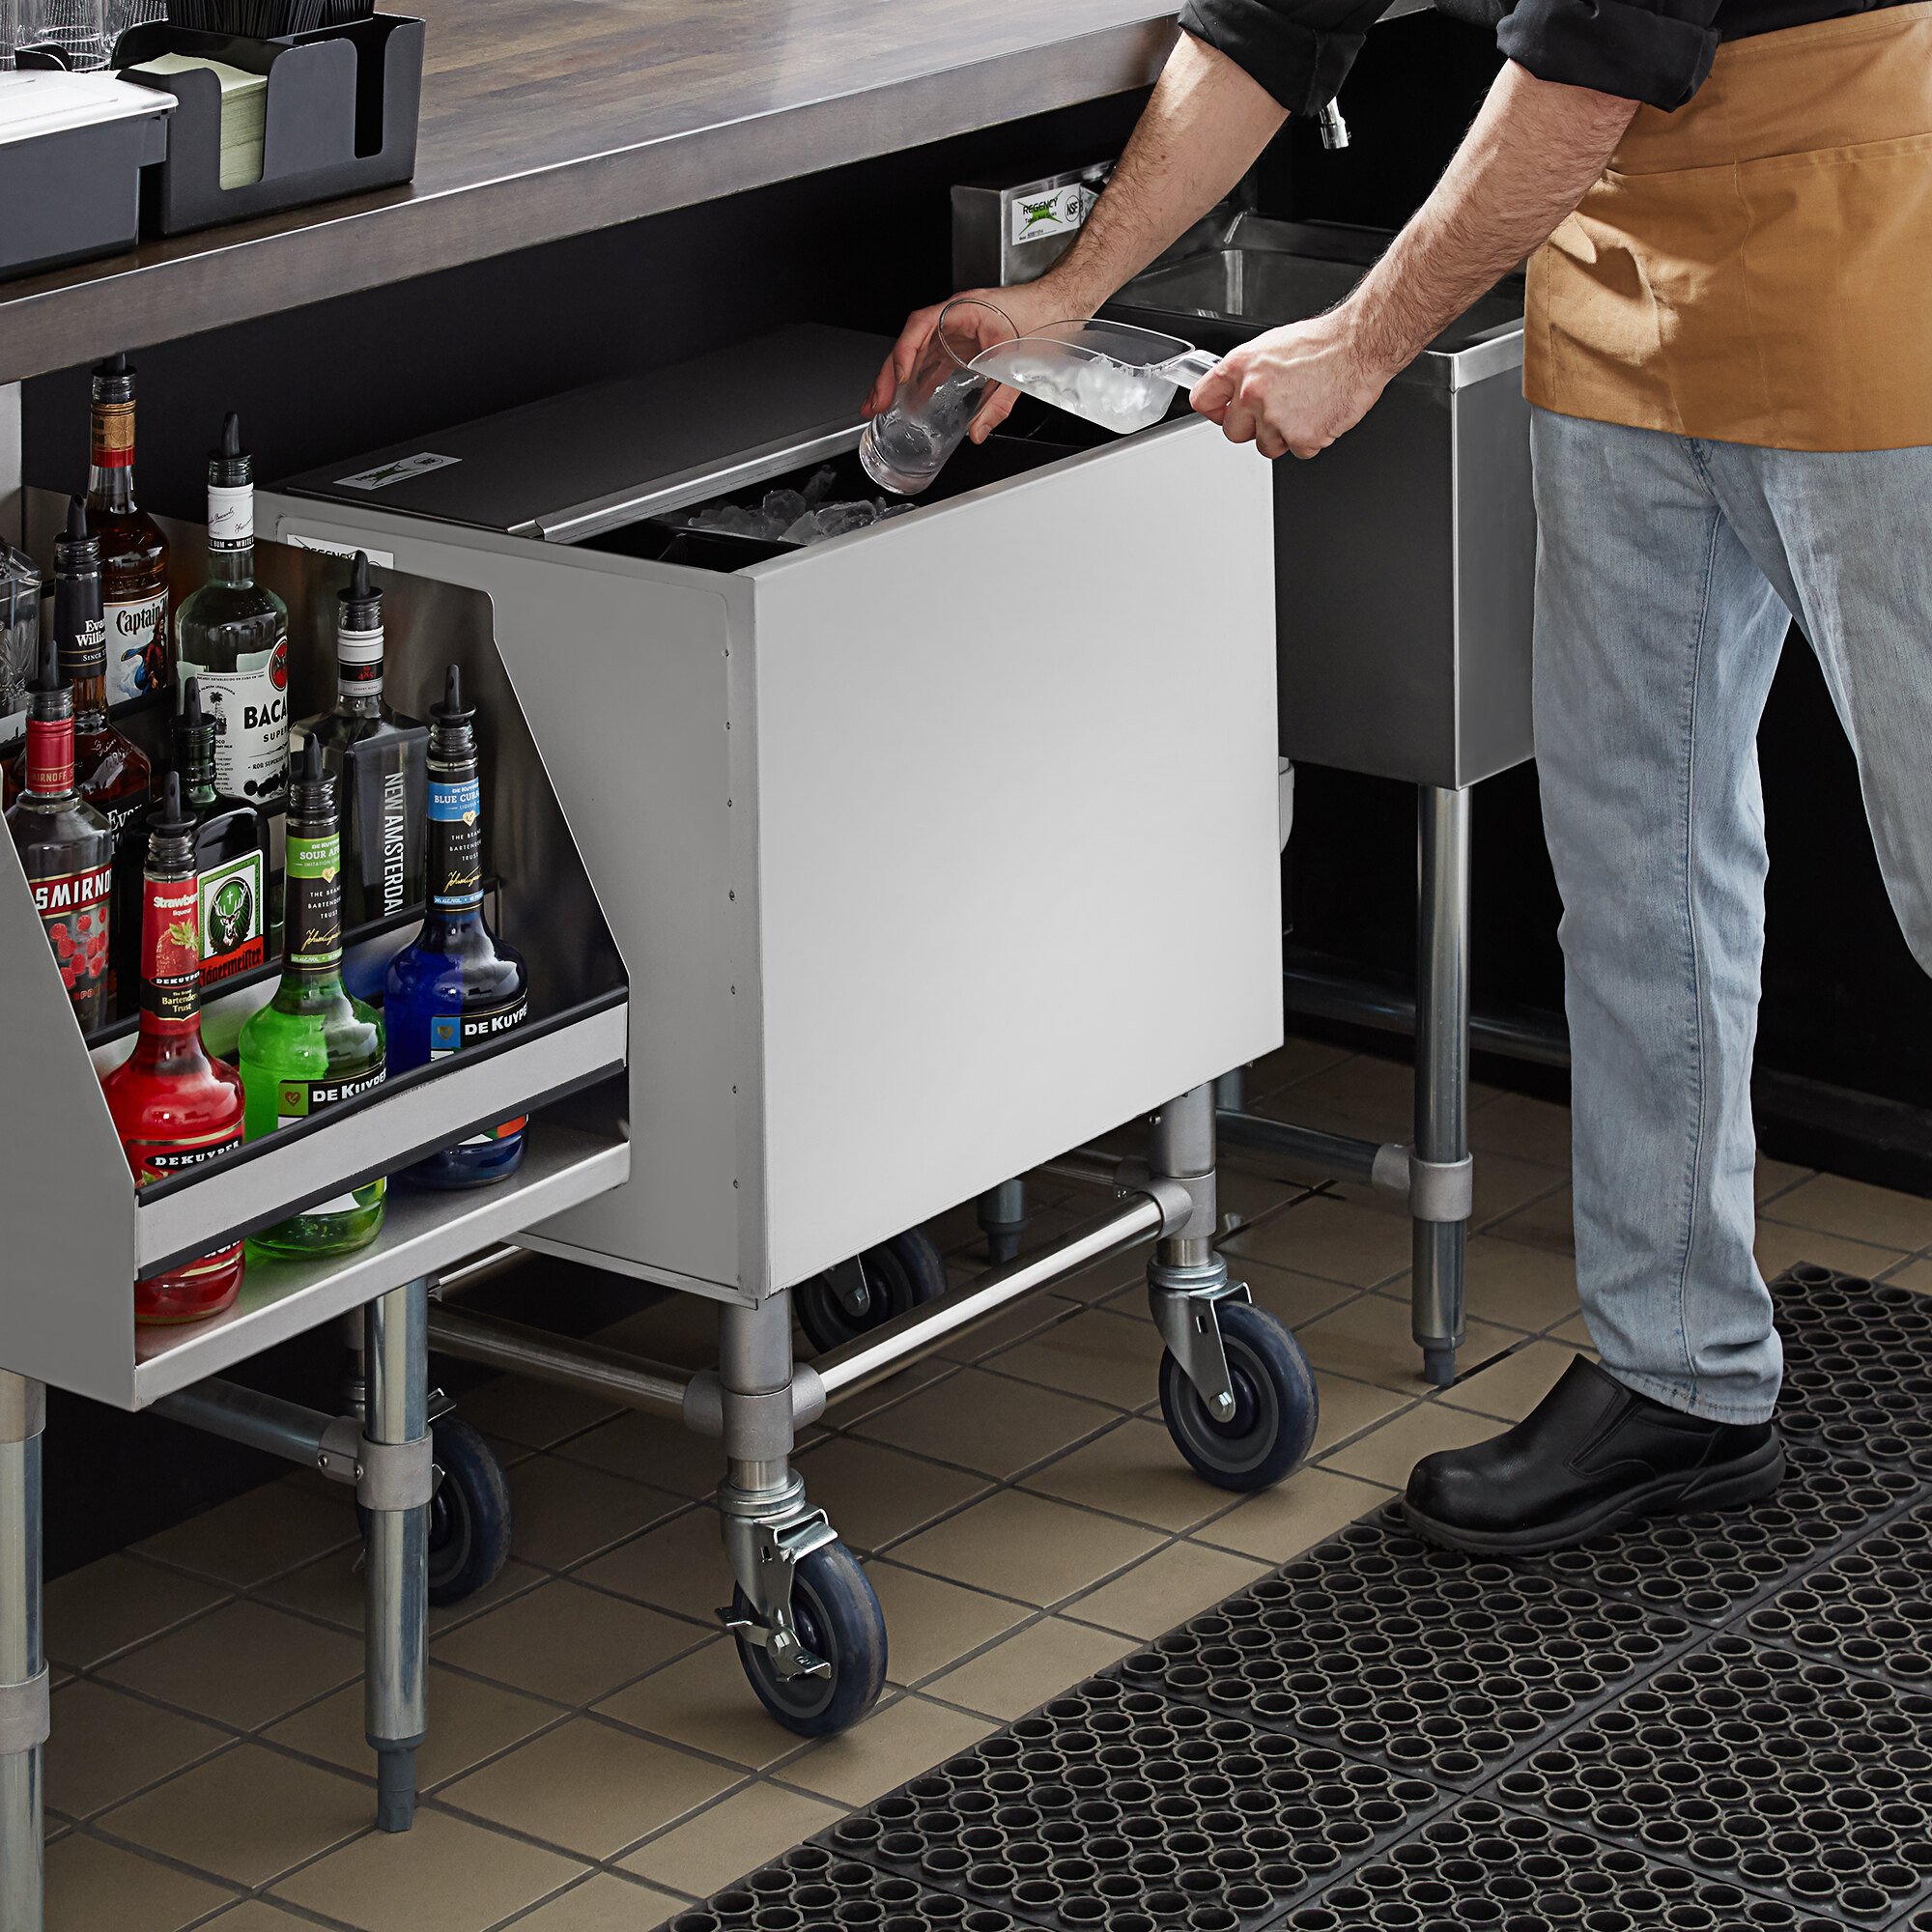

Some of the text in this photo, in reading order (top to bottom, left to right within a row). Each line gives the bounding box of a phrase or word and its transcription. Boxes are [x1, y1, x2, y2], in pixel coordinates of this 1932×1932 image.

[1022, 197, 1059, 214] REGENCY
[1066, 201, 1079, 216] NSF
[116, 603, 160, 637] Captain
[384, 772, 404, 810] NEW
[434, 794, 457, 804] BLUE
[299, 850, 327, 861] SOUR
[462, 851, 479, 861] TRUST
[320, 909, 338, 920] TRUST
[172, 1003, 191, 1014] Trust
[465, 1022, 489, 1037] DE
[312, 1089, 338, 1102] DE
